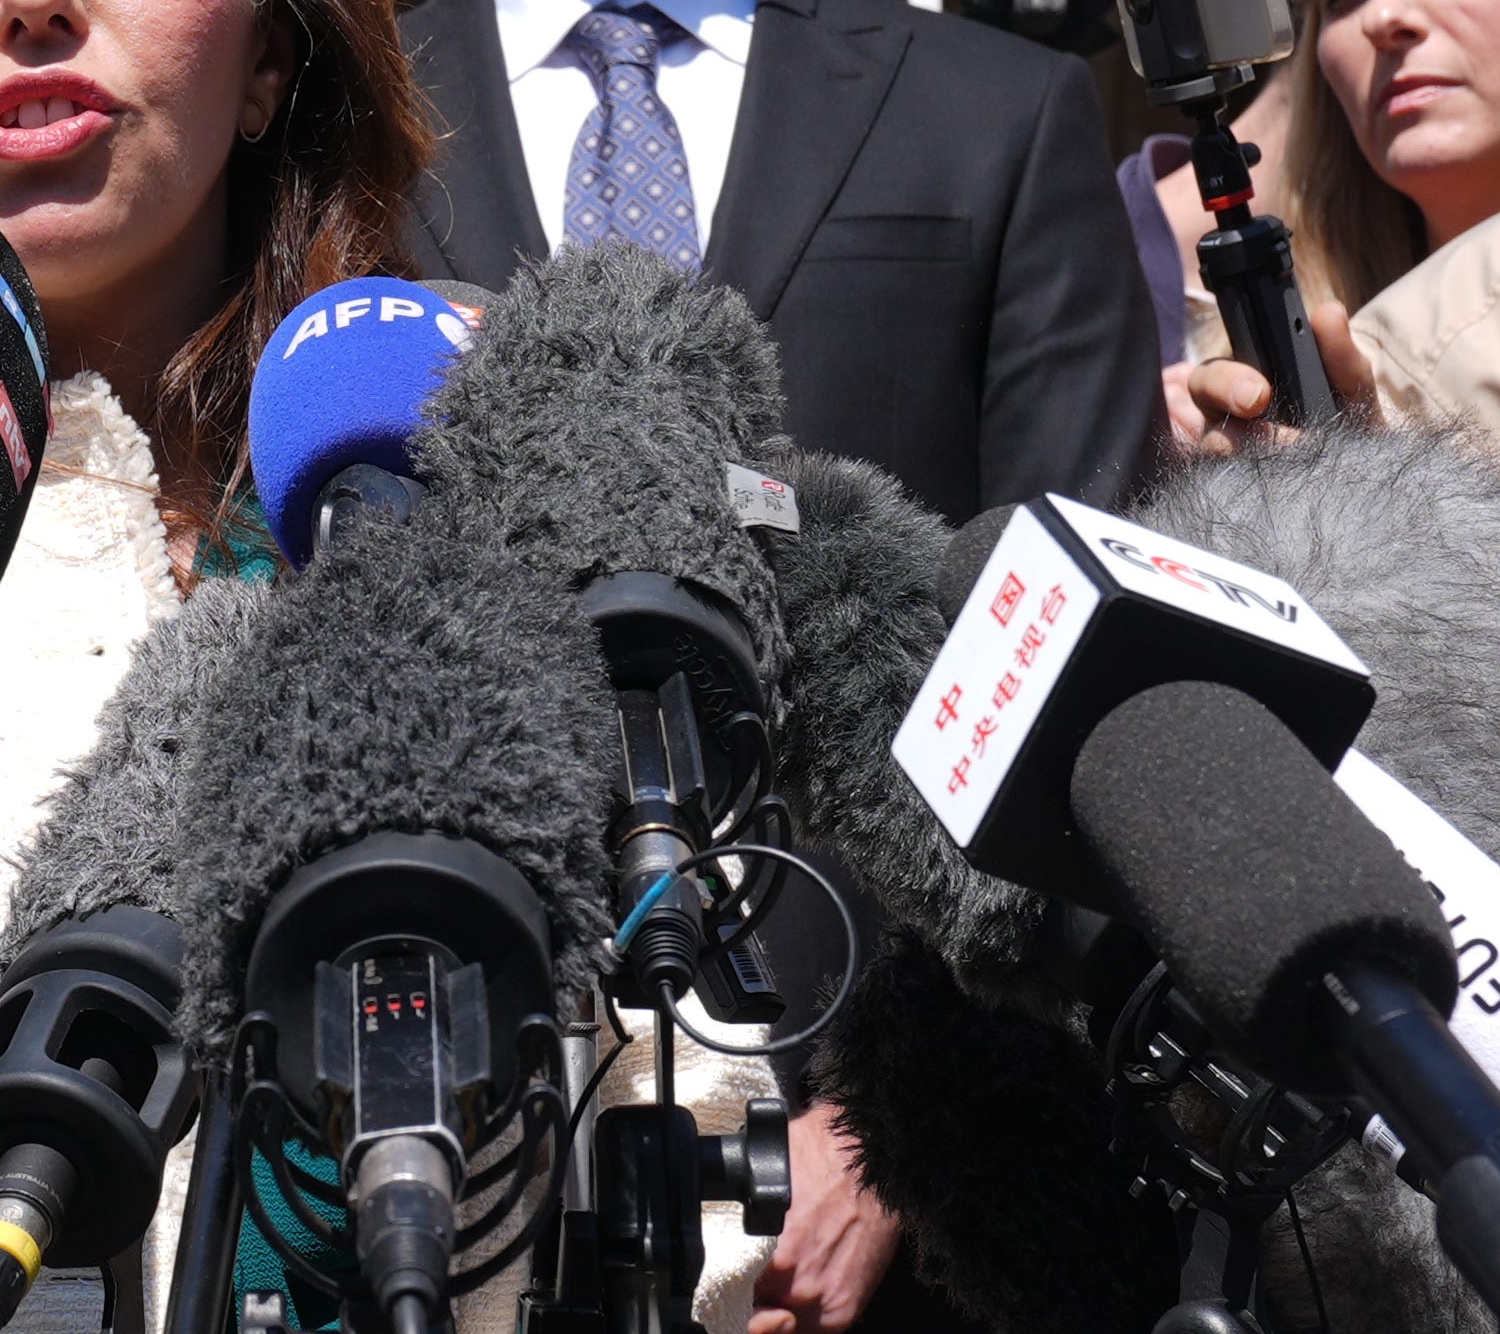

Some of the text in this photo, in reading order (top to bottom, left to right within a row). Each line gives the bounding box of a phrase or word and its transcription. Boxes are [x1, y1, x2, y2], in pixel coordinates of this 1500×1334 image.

[283, 296, 425, 360] AFP
[1098, 536, 1300, 625] CCTV
[946, 581, 1070, 797] 中央电视台
[4, 1172, 50, 1192] AUSTRALIA
